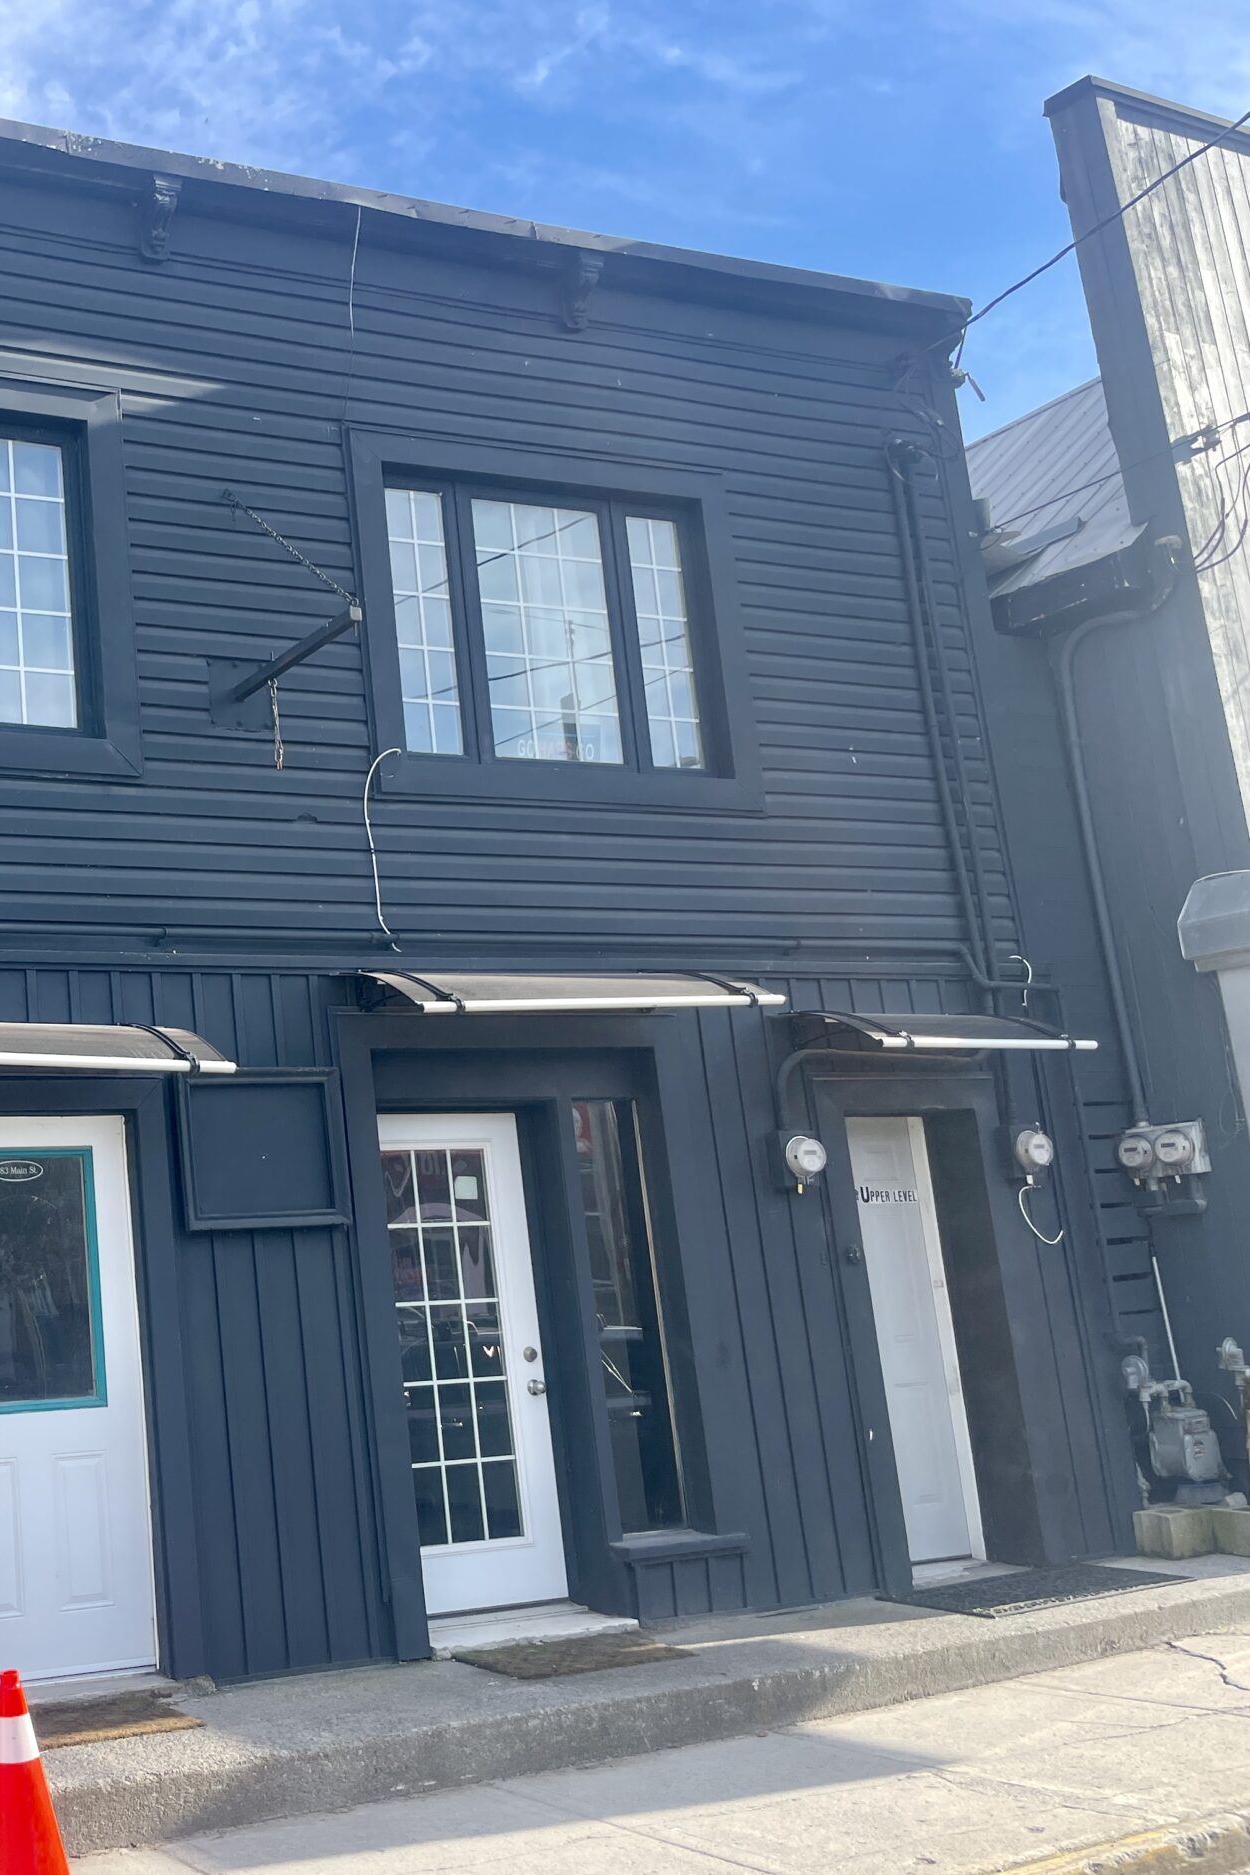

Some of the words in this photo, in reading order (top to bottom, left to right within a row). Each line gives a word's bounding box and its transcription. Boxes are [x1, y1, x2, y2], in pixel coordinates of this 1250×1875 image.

[10, 1165, 28, 1175] Main
[860, 1186, 891, 1203] UPPER
[893, 1190, 918, 1203] LEVEL
